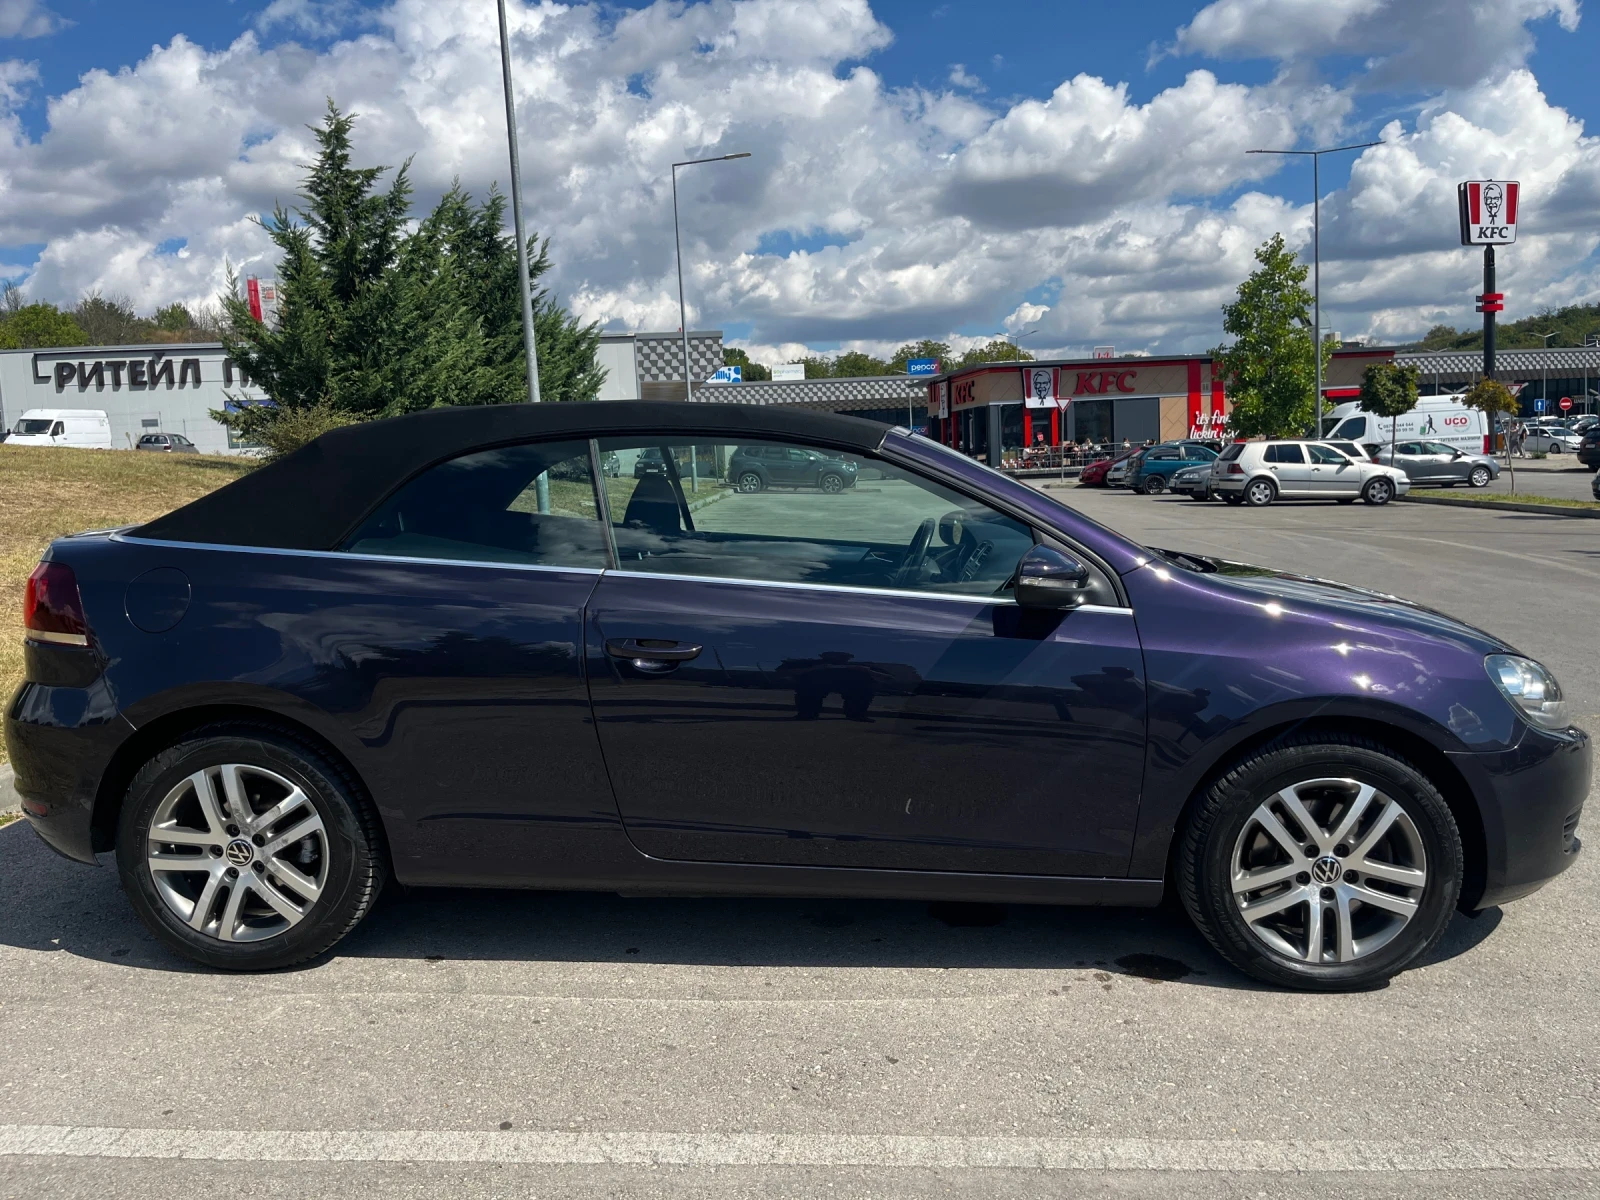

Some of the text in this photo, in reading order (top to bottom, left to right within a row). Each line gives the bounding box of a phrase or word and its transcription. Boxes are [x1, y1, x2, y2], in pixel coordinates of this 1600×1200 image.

[1477, 226, 1509, 239] KFC
[56, 352, 201, 388] РИТЕЙЛ
[911, 364, 937, 373] pepco
[1073, 370, 1137, 395] KFC
[954, 380, 975, 405] KFC
[1195, 410, 1210, 425] it's
[1444, 417, 1467, 426] UCO
